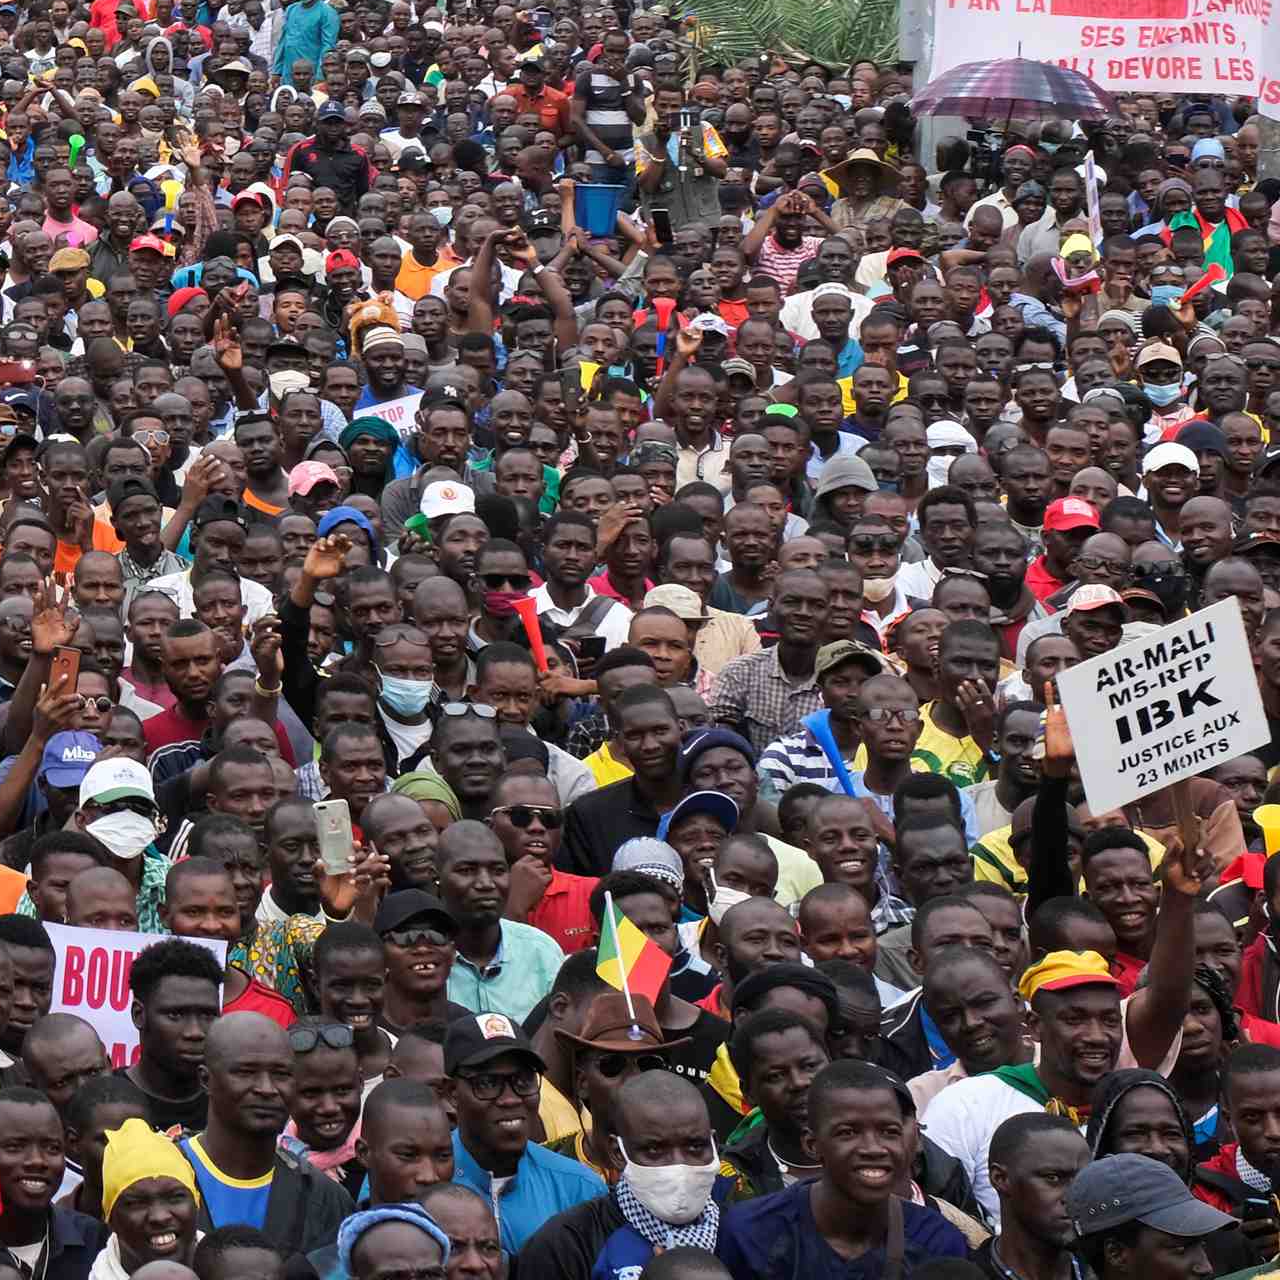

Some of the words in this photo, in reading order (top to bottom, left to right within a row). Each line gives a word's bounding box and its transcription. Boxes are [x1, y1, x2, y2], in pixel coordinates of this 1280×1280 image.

[1080, 25, 1126, 48] SES
[1107, 56, 1202, 80] DEVORE
[1214, 57, 1255, 82] LES
[1096, 621, 1216, 692] AR-MALI
[1108, 652, 1212, 710] M5-RFP
[1115, 675, 1222, 745] IBK
[1117, 728, 1196, 774] JUSTICE
[1202, 710, 1241, 738] AUX
[1136, 767, 1158, 788] 23
[1164, 737, 1230, 776] MORTS
[62, 945, 143, 1012] BOU
